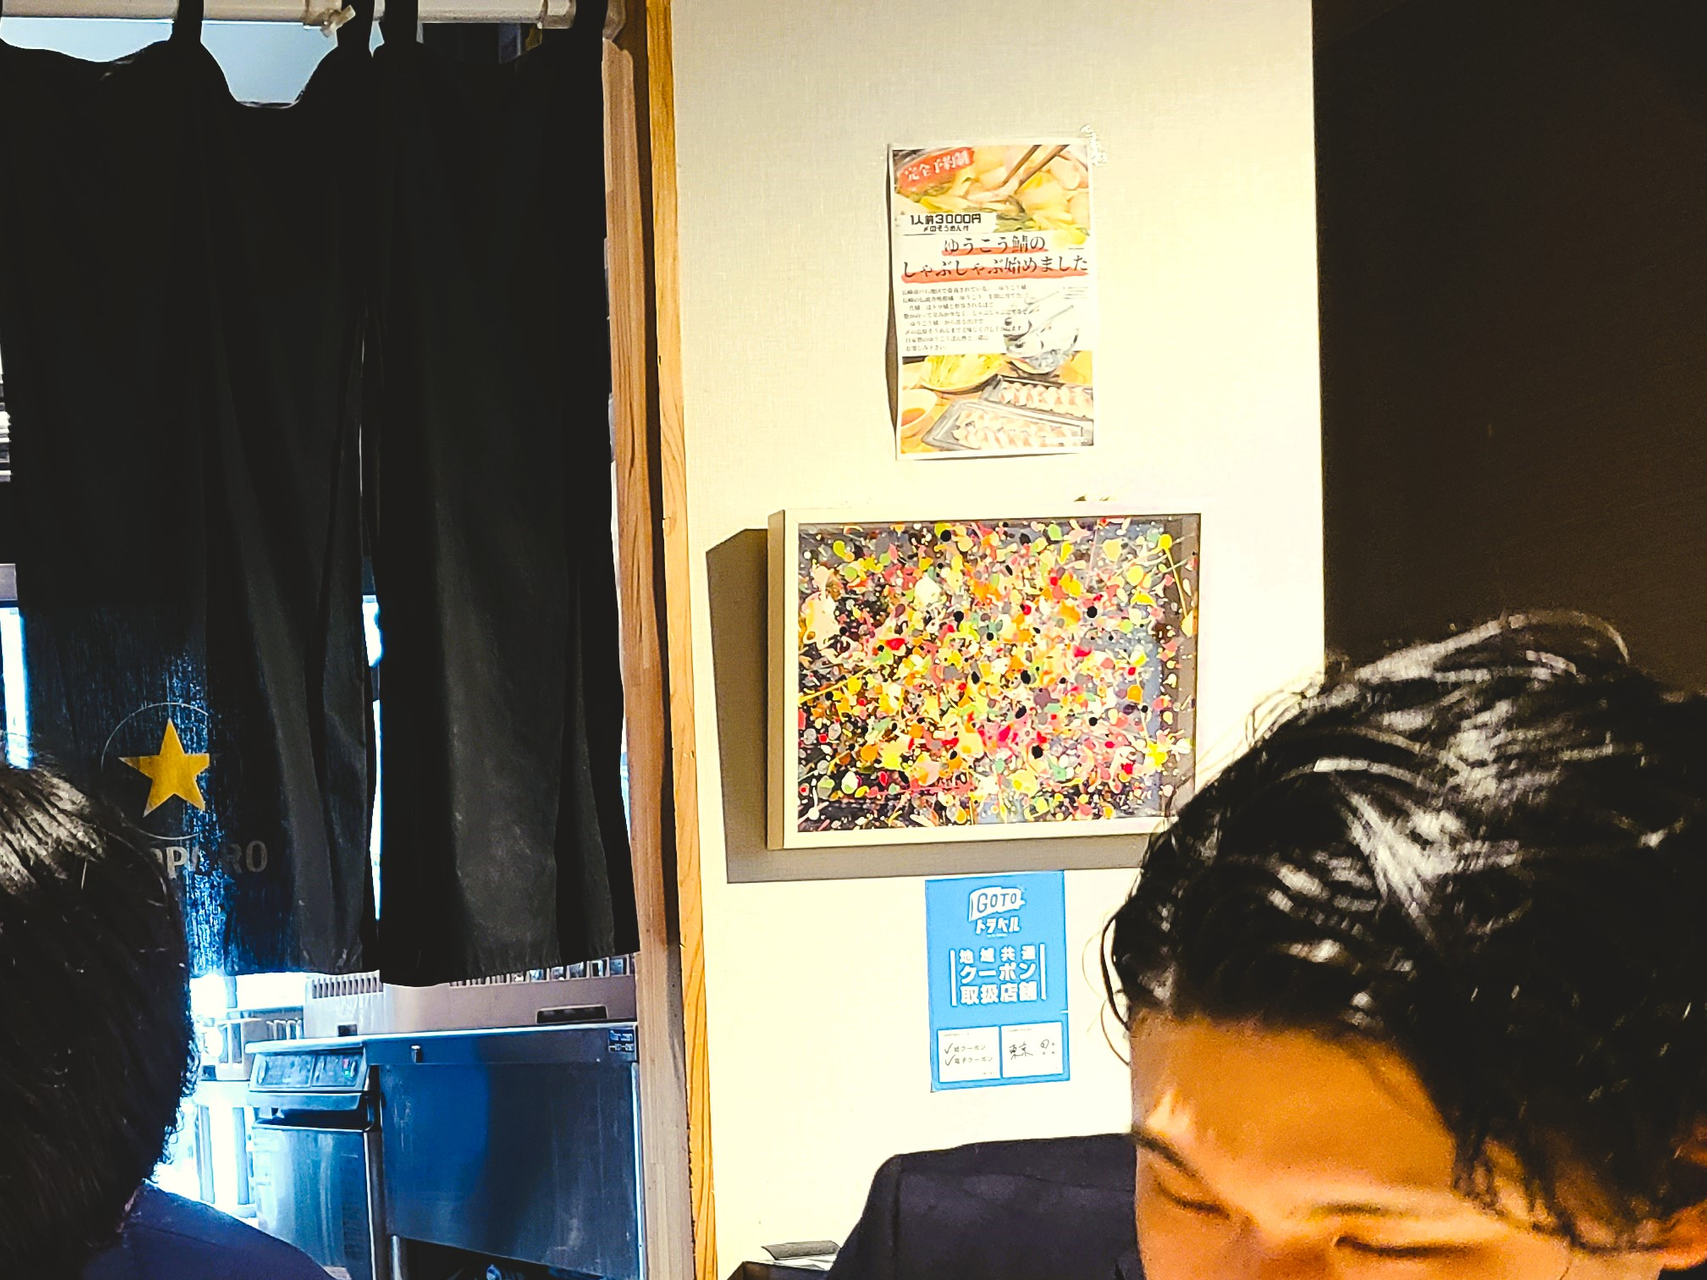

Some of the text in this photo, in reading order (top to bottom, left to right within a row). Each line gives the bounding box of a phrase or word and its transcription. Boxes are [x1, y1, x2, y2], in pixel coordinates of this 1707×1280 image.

[903, 255, 1089, 278] しゃぶしゃぶ始めました
[976, 917, 1021, 935] トラベル
[959, 945, 1036, 964] 地域共通
[960, 962, 1037, 984] クーポン
[960, 981, 1038, 1005] 取扱店舗
